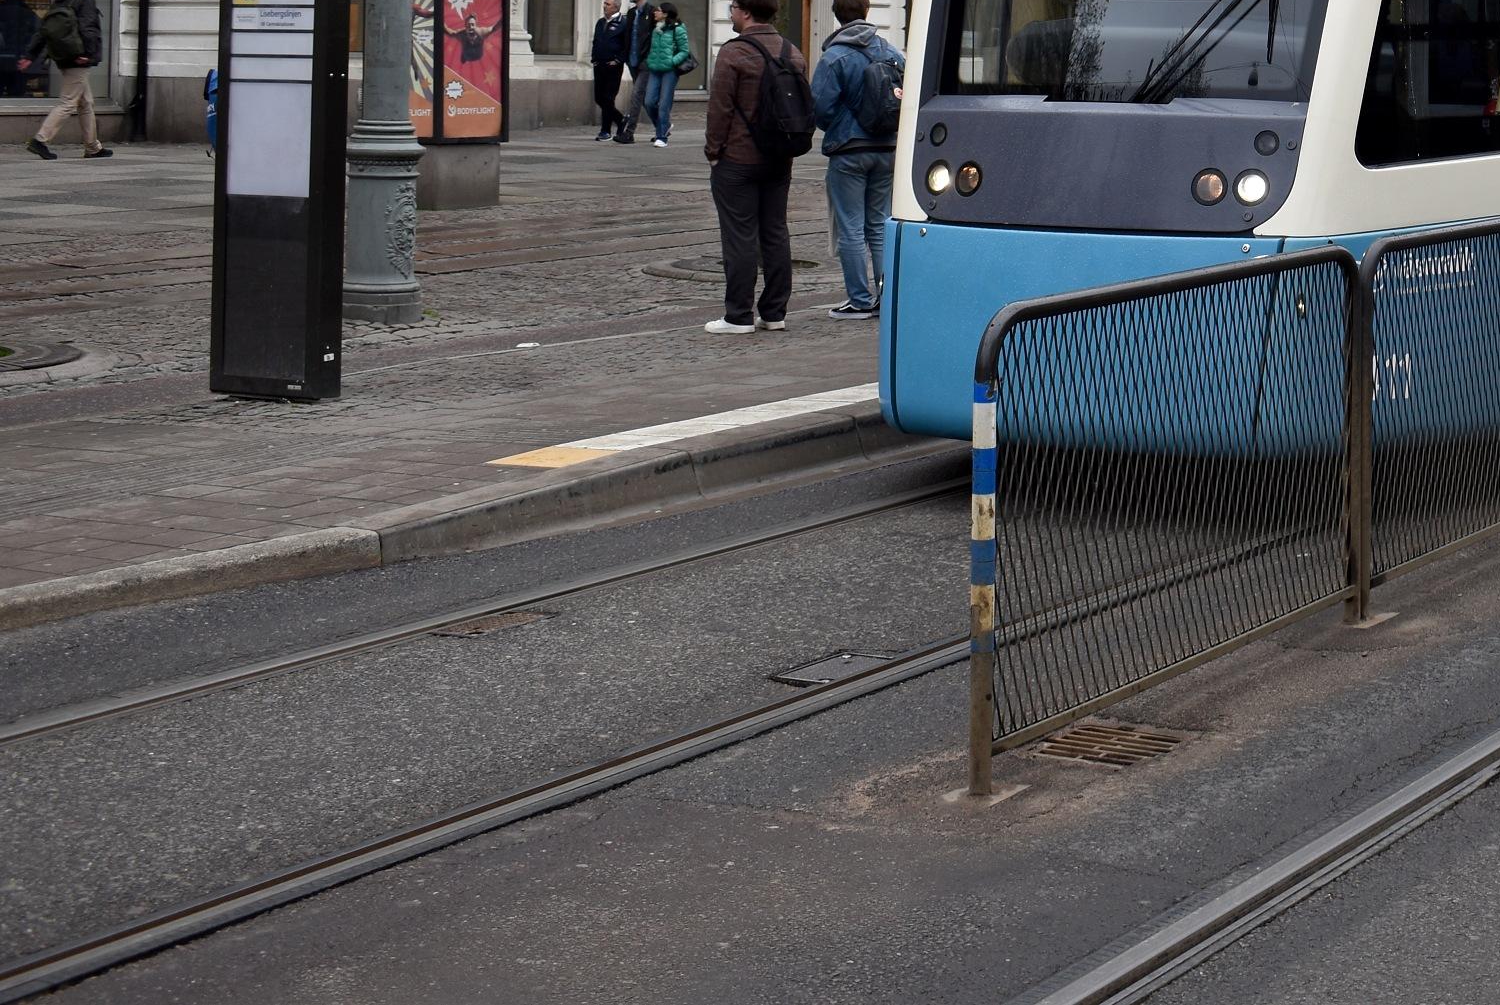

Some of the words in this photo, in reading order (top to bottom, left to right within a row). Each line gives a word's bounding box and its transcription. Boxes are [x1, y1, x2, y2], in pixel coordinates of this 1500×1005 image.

[408, 108, 433, 117] FLIGHT
[457, 107, 496, 115] BODYFLIGHT
[1373, 353, 1411, 401] 11
